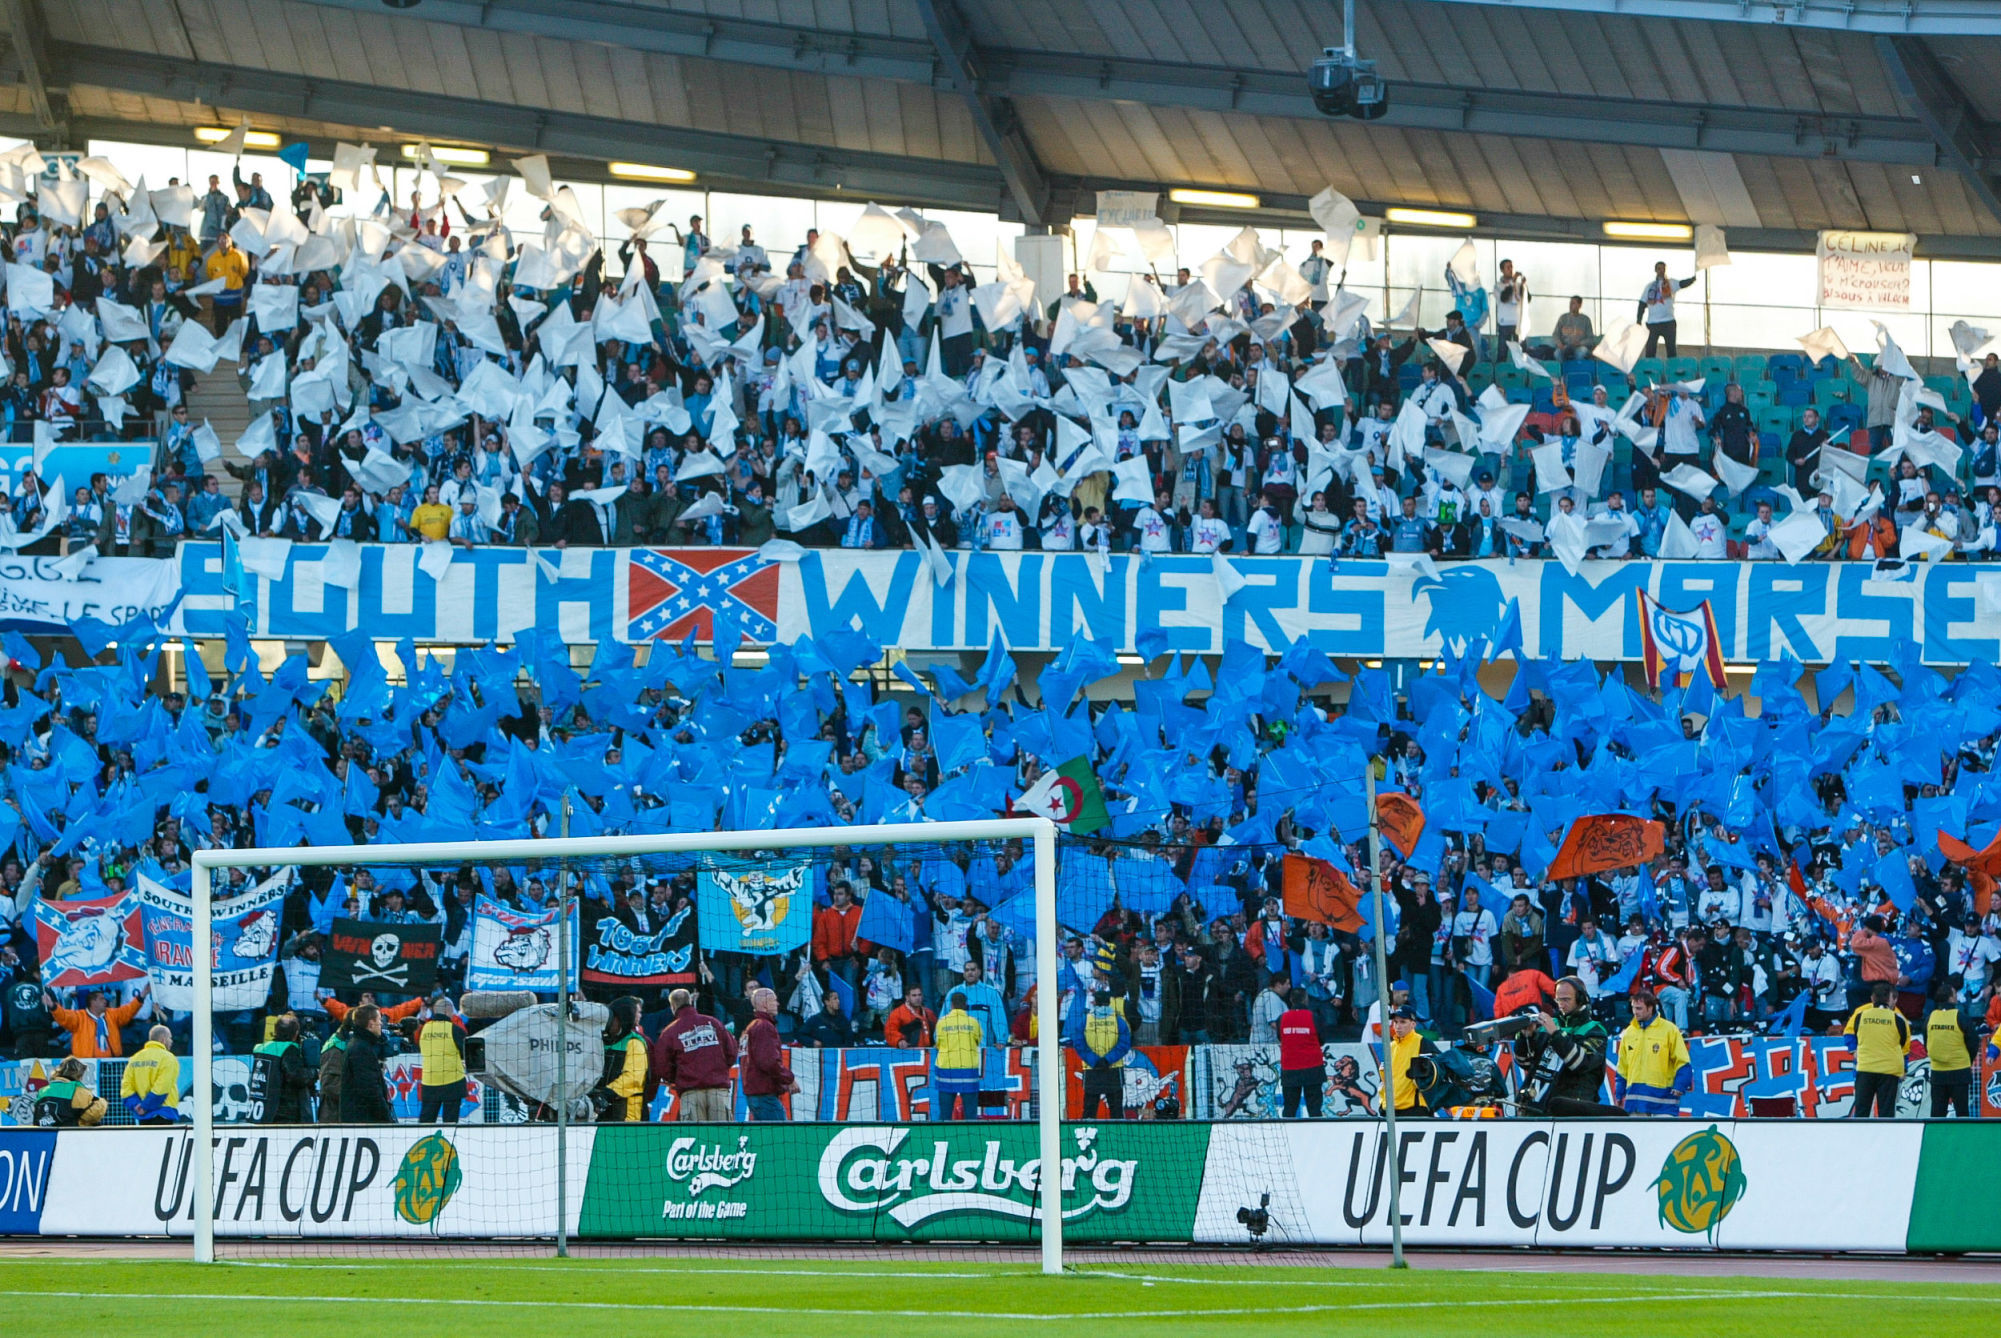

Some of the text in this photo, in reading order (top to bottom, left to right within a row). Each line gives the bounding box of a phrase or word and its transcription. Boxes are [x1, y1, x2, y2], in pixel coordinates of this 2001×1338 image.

[181, 543, 617, 641] SOUTH
[798, 549, 1389, 654] WINNERS
[143, 890, 192, 915] SOUTH
[169, 967, 268, 988] MASEILLE
[586, 943, 693, 976] WINNERS
[530, 1037, 582, 1055] PHILPS
[666, 1136, 757, 1181] Carlsberg
[818, 1127, 1138, 1210] Carlsberg
[280, 1136, 380, 1223] CUP
[1343, 1130, 1636, 1232] UEFA CUP
[662, 1200, 747, 1218] Part of the Game
